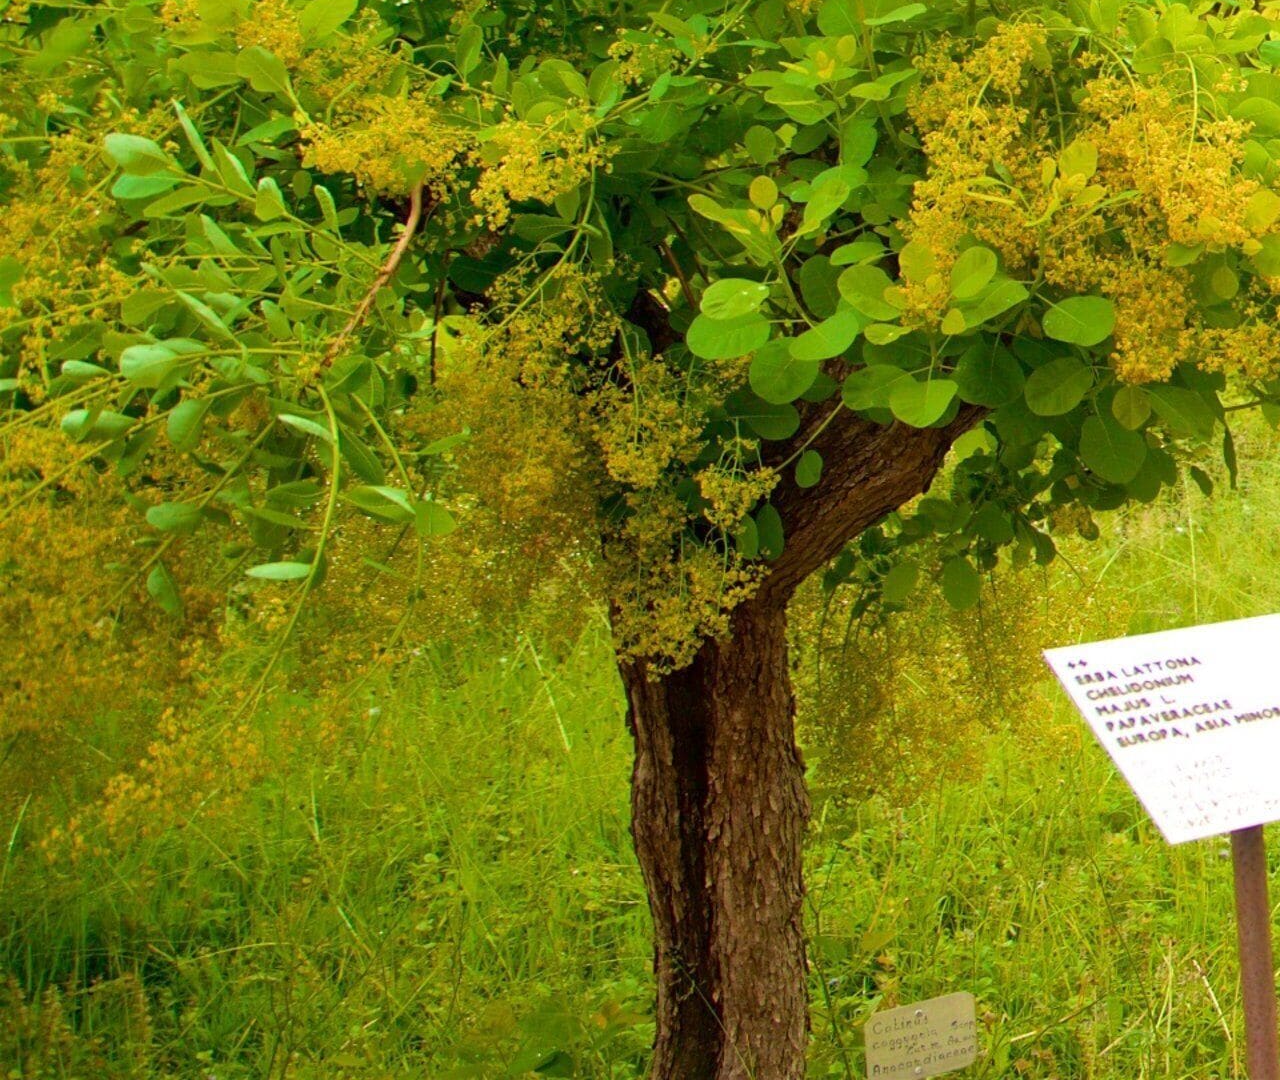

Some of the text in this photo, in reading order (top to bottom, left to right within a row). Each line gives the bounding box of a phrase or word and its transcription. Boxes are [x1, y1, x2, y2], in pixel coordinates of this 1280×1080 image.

[1074, 656, 1202, 686] ERBA LATTONA
[1086, 673, 1195, 701] CHELIDONIUM
[1095, 697, 1151, 716] MAJUS
[1105, 699, 1233, 732] PAPAVERACEAE
[1116, 726, 1191, 748] EUROPA,
[1195, 717, 1231, 734] ASIA
